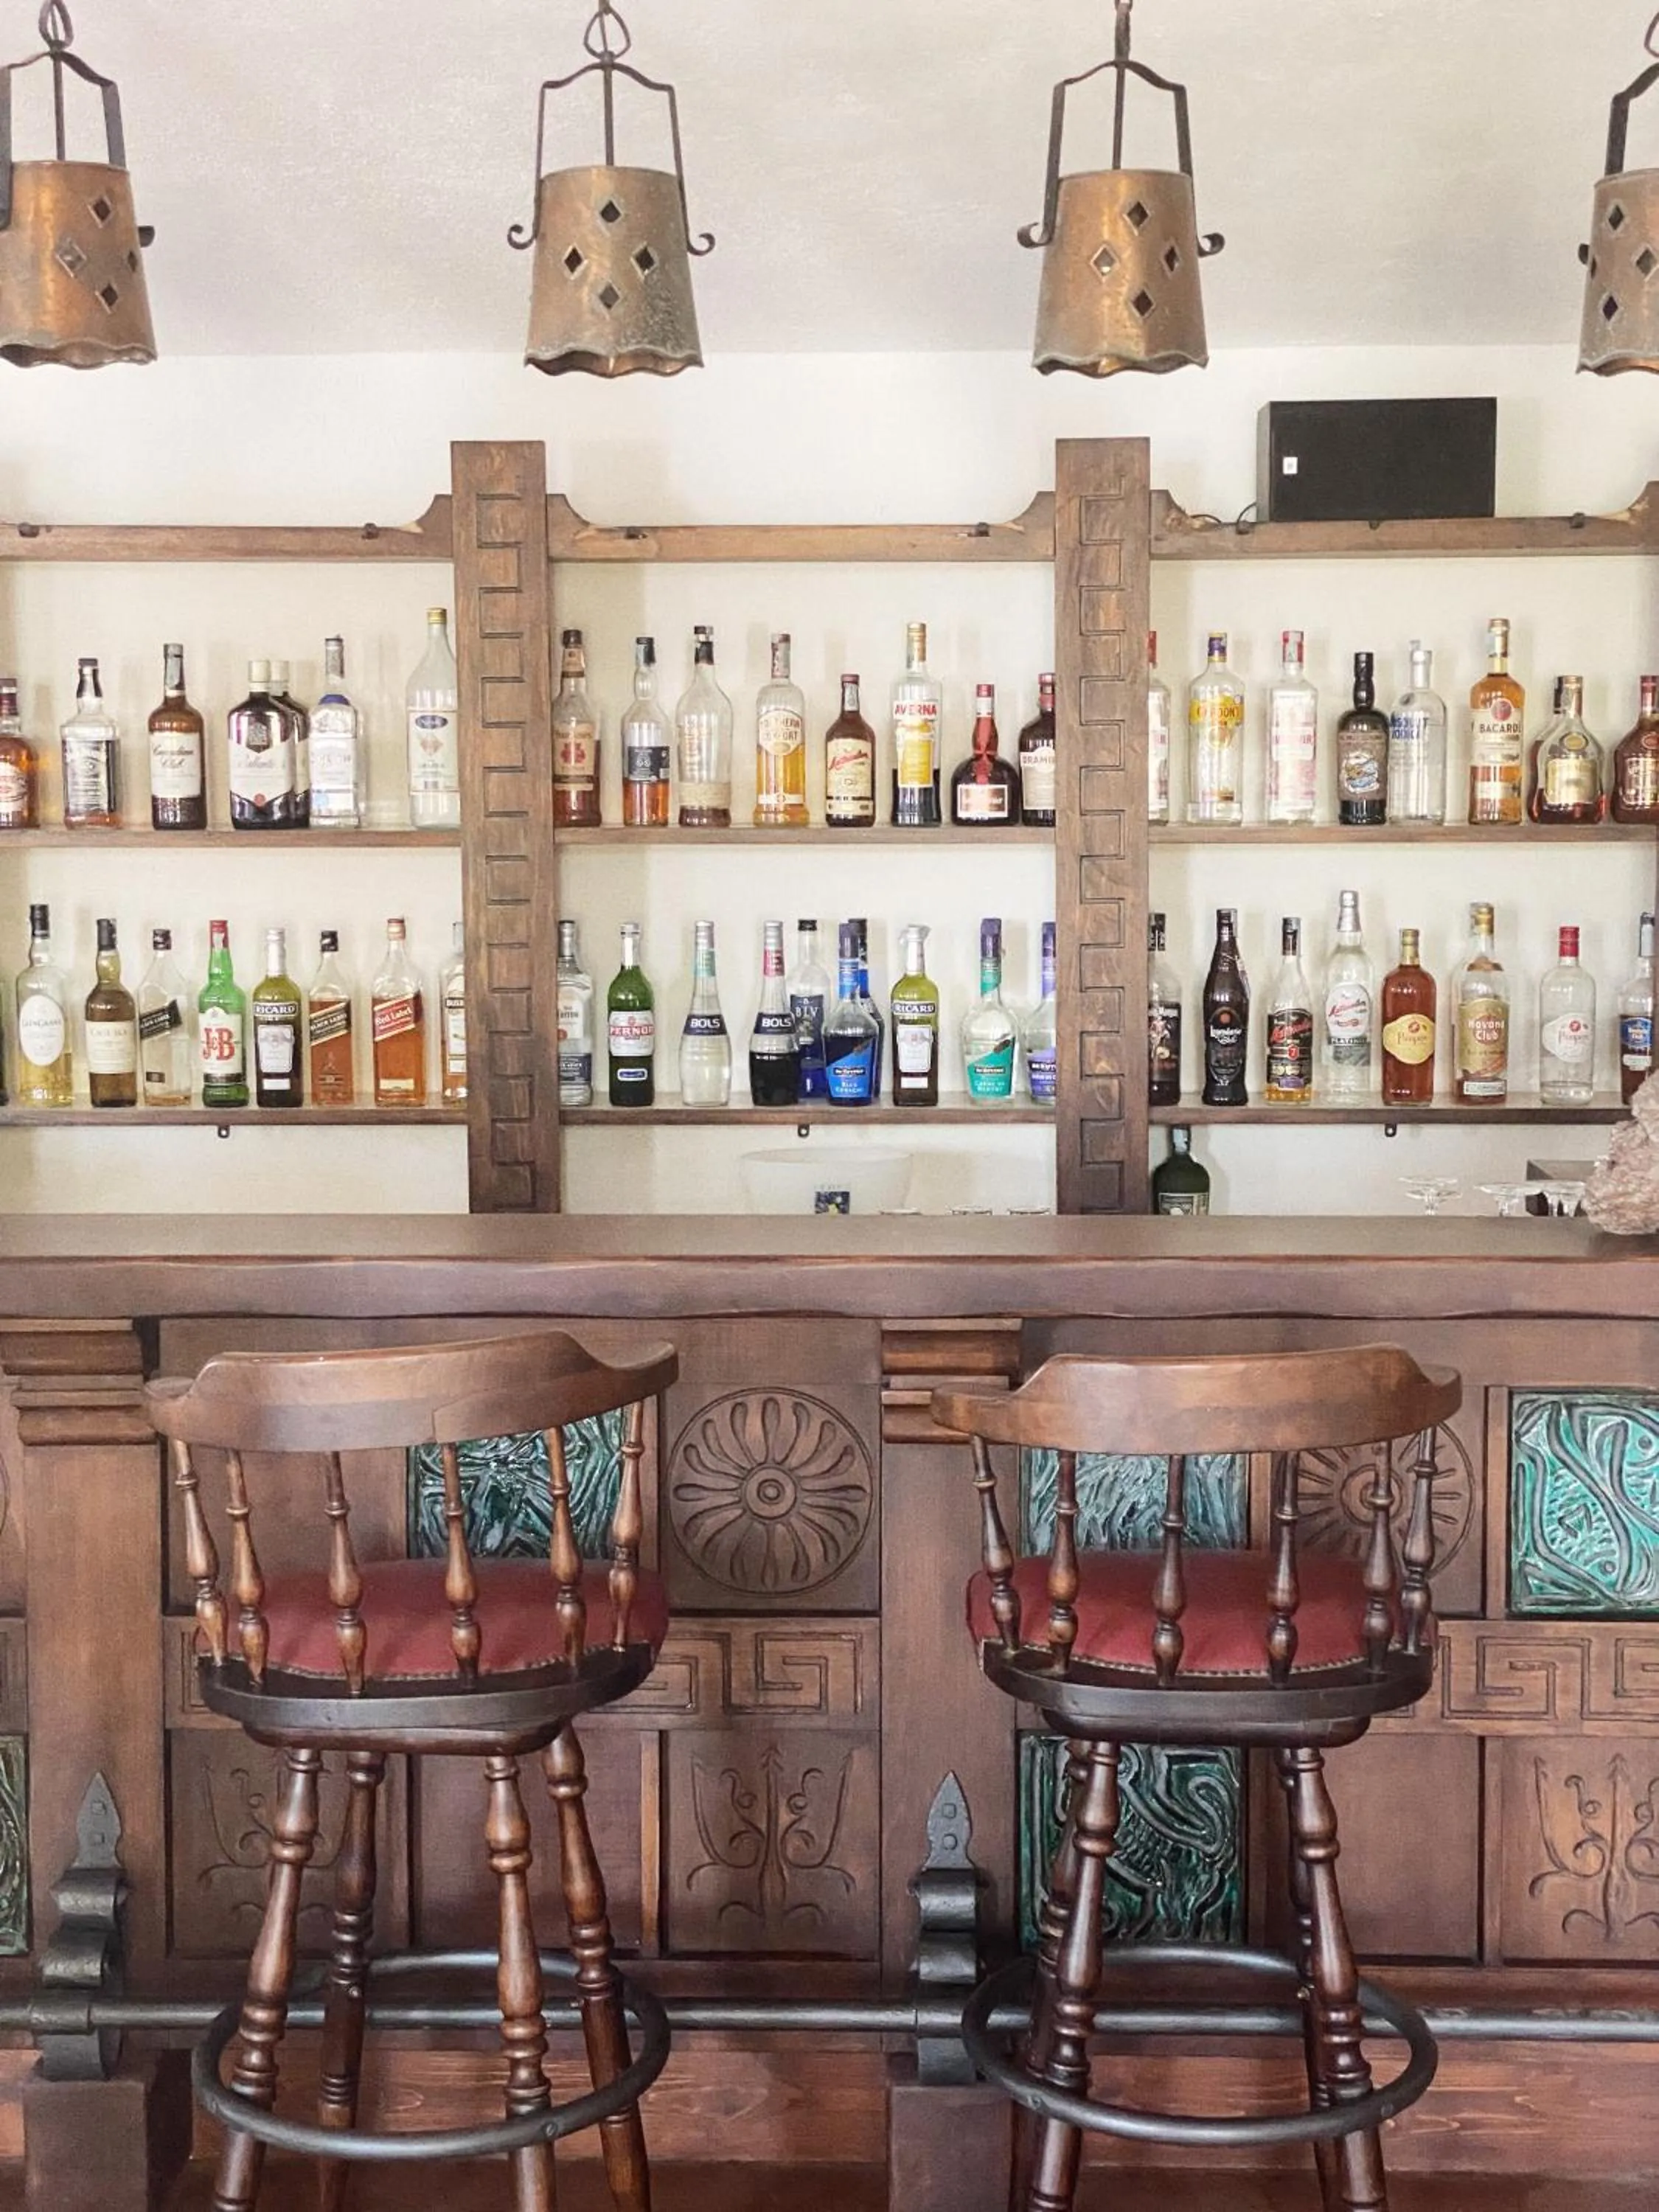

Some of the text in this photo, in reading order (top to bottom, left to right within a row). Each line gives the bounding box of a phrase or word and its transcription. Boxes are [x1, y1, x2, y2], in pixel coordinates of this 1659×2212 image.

[255, 1005, 296, 1014] RICARD
[390, 1005, 413, 1019] Label
[894, 1004, 934, 1013] RICARD
[690, 1018, 721, 1029] BOLS
[761, 1017, 792, 1028] BOLS
[1468, 1019, 1505, 1029] Havana
[610, 1026, 655, 1037] PERNOD
[1475, 1031, 1500, 1041] Club
